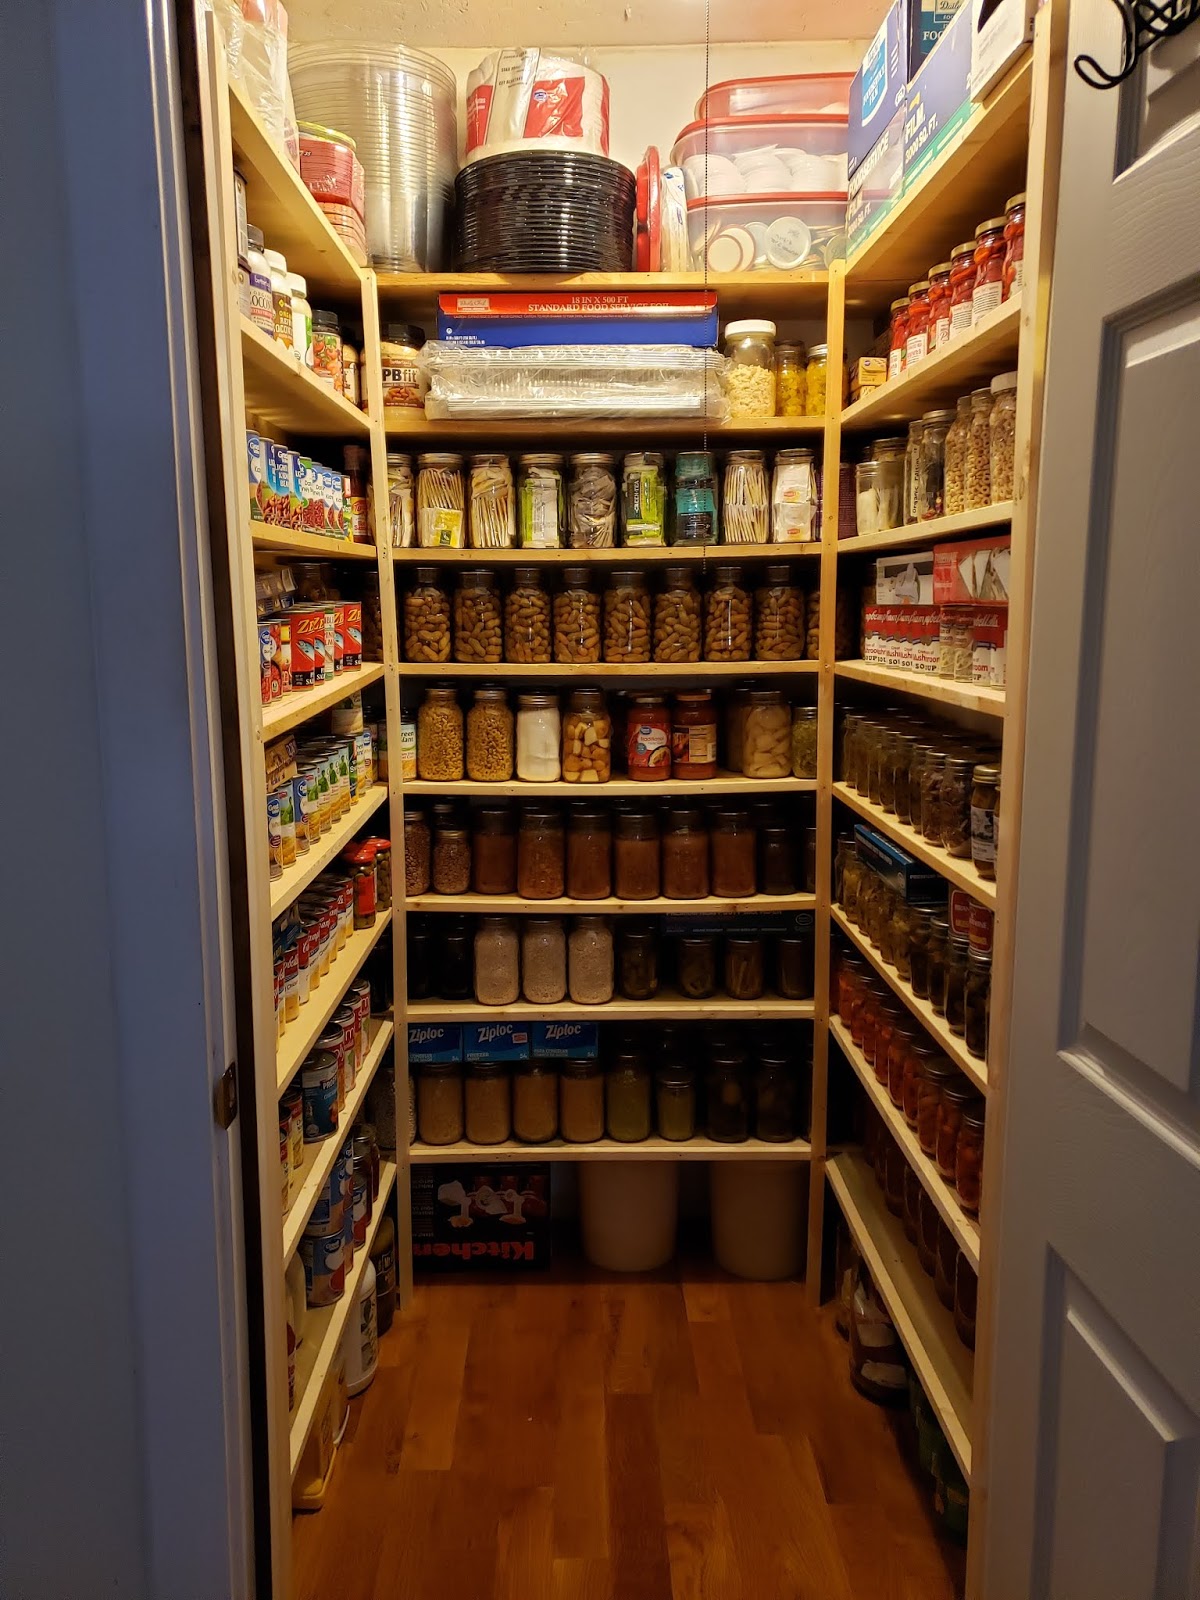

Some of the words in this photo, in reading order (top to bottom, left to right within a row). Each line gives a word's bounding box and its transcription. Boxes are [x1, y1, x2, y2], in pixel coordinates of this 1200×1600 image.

[528, 303, 580, 312] STANDARD
[582, 303, 608, 312] FOOD
[408, 1027, 444, 1044] Ziploc
[477, 1024, 513, 1043] Ziploc
[545, 1024, 582, 1041] Ziploc
[413, 1241, 535, 1261] Kitchen
